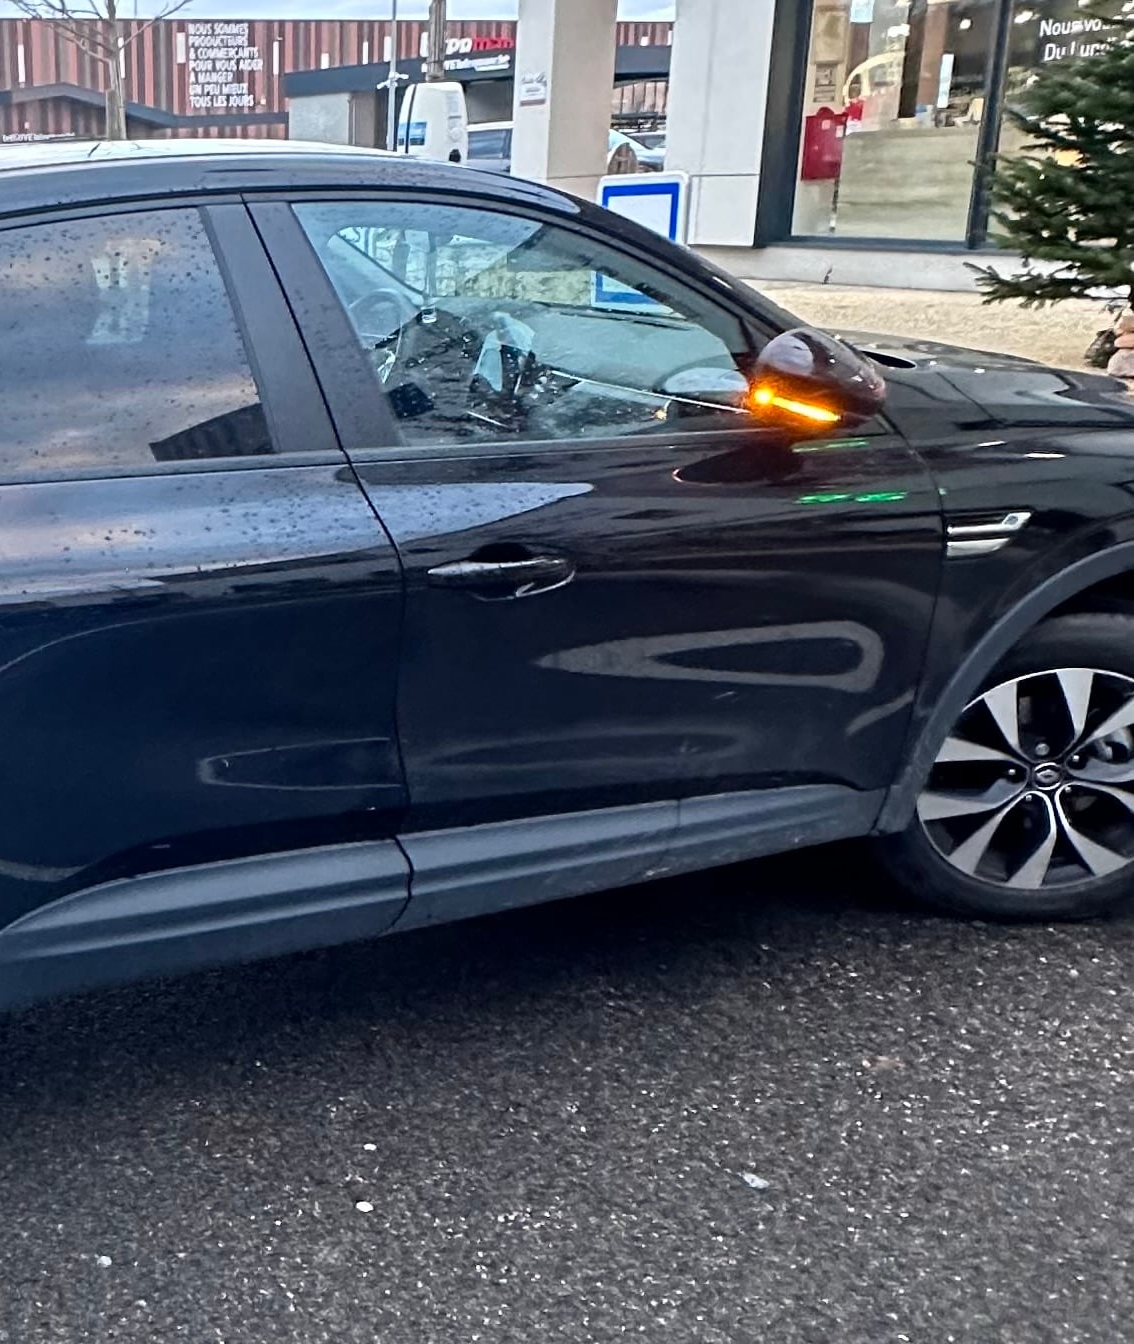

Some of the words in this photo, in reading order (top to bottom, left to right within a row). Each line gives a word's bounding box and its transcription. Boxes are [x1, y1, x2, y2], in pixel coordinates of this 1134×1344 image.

[188, 23, 212, 35] NOUS
[213, 23, 248, 34] SOMMES
[188, 35, 248, 47] PRODUCTEURS
[189, 60, 213, 72] POUR
[215, 59, 237, 71] VOUS
[239, 59, 263, 71] AIDER
[198, 71, 233, 84] MANGER
[189, 84, 202, 96] UN
[204, 84, 220, 96] PEU
[222, 83, 248, 95] MIEUX
[189, 96, 212, 108] TOUS
[213, 95, 227, 107] LES
[229, 95, 254, 107] JOURS
